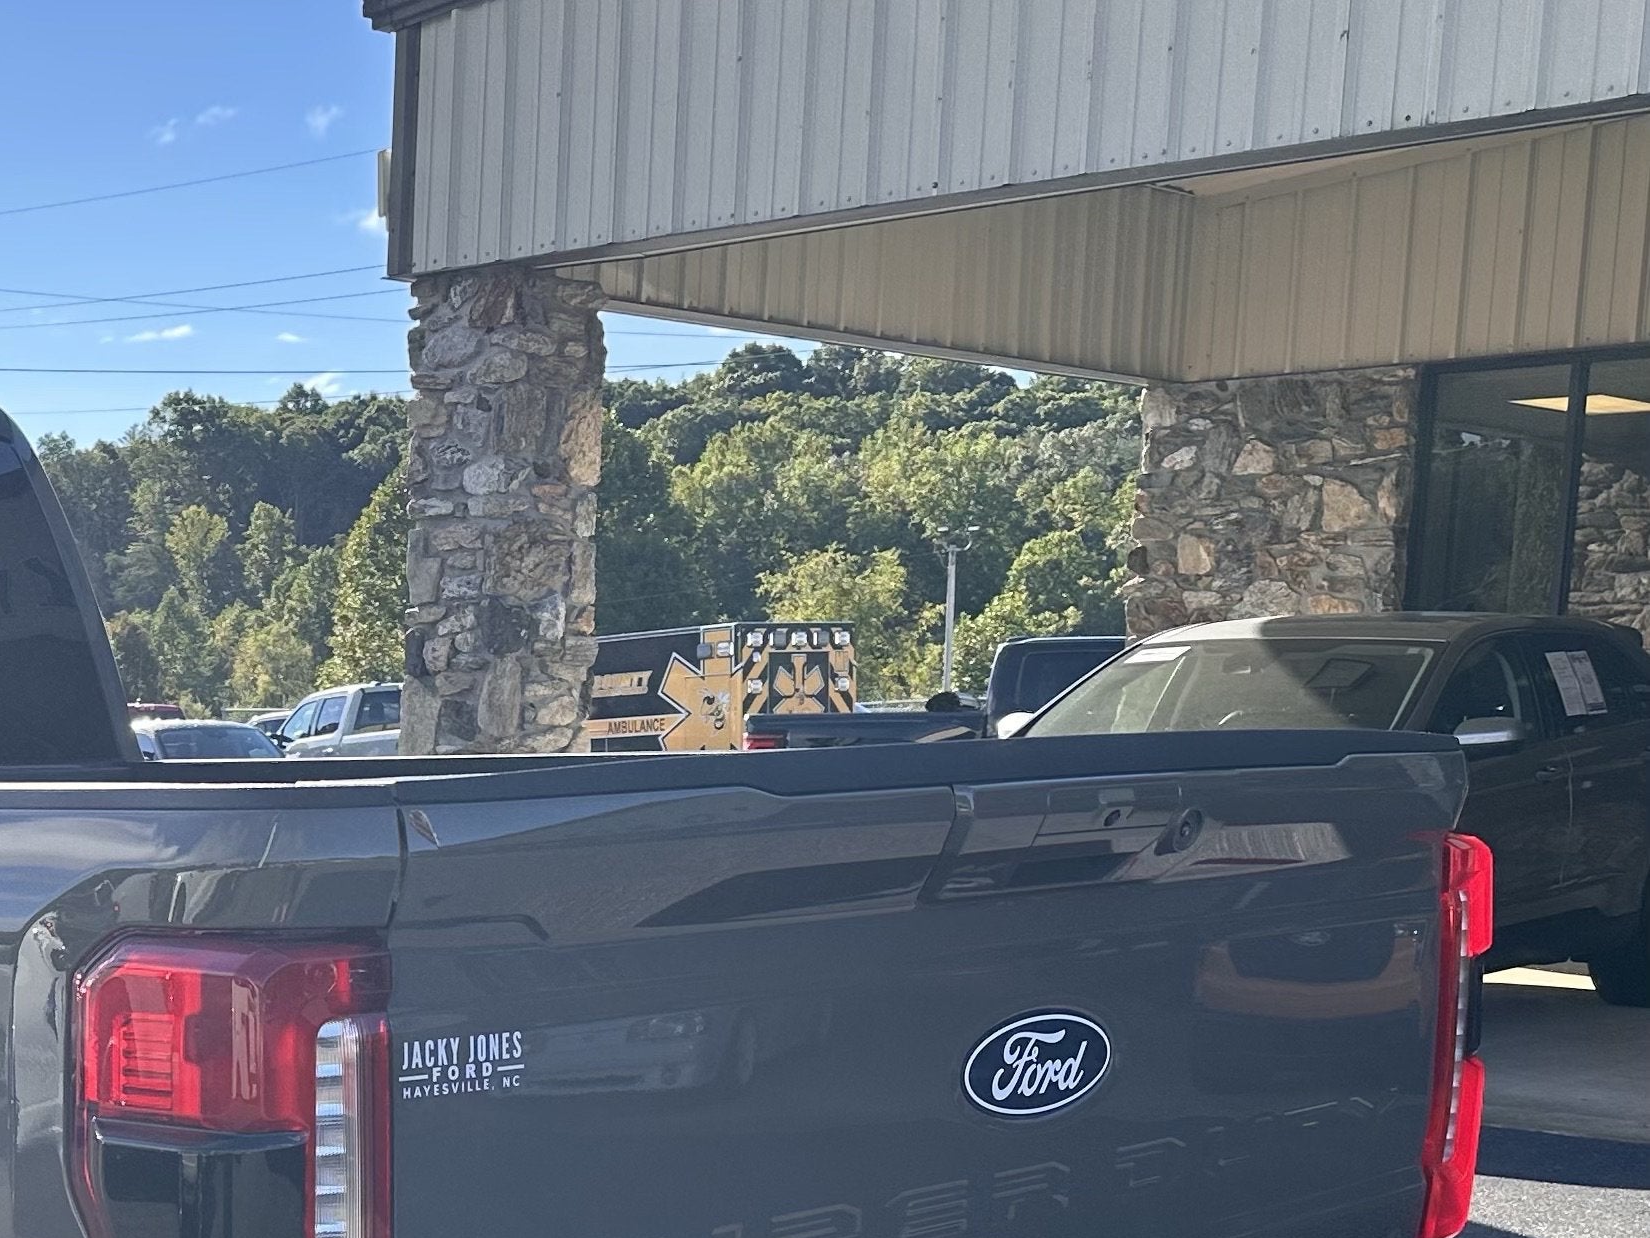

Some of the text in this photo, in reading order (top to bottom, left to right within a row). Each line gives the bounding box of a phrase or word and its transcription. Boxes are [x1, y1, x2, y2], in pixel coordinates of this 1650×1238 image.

[607, 718, 666, 735] AMBULANCE
[402, 1031, 523, 1070] JACKY JONES
[432, 1061, 494, 1083] FORD
[991, 1028, 1088, 1101] Ford
[402, 1074, 521, 1099] HAYESVILLE, NC
